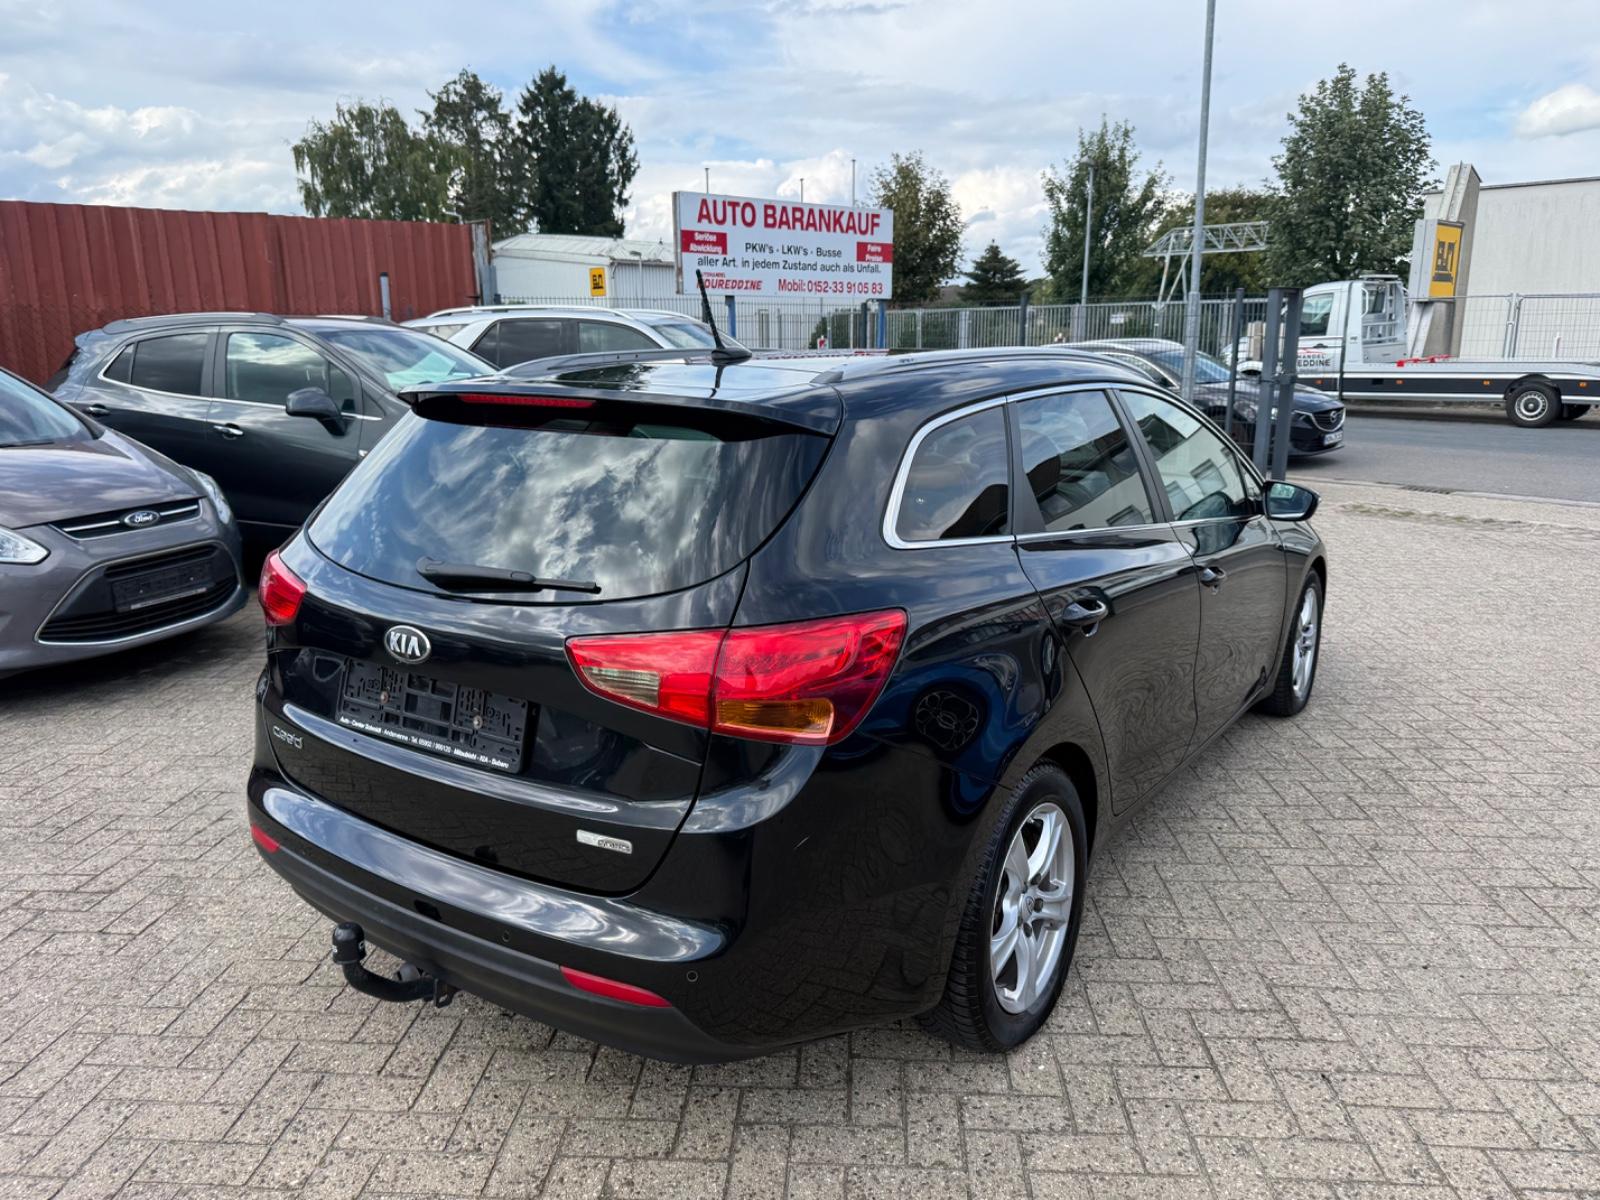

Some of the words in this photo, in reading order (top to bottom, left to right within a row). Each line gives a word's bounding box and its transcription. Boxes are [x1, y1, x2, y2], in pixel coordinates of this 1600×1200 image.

[697, 198, 756, 227] AUTO
[764, 204, 880, 236] BARANKAUF
[745, 242, 774, 254] PKW's
[782, 244, 808, 256] LKW's
[816, 247, 842, 258] Busse
[697, 256, 719, 267] aller
[742, 258, 750, 269] in
[751, 259, 780, 271] jedem
[782, 260, 818, 272] Zustand
[820, 261, 840, 272] auch
[842, 262, 854, 273] als
[778, 278, 806, 292] Mobil:
[872, 282, 883, 294] 83
[1297, 359, 1330, 367] EDDINE
[390, 631, 421, 656] KIA
